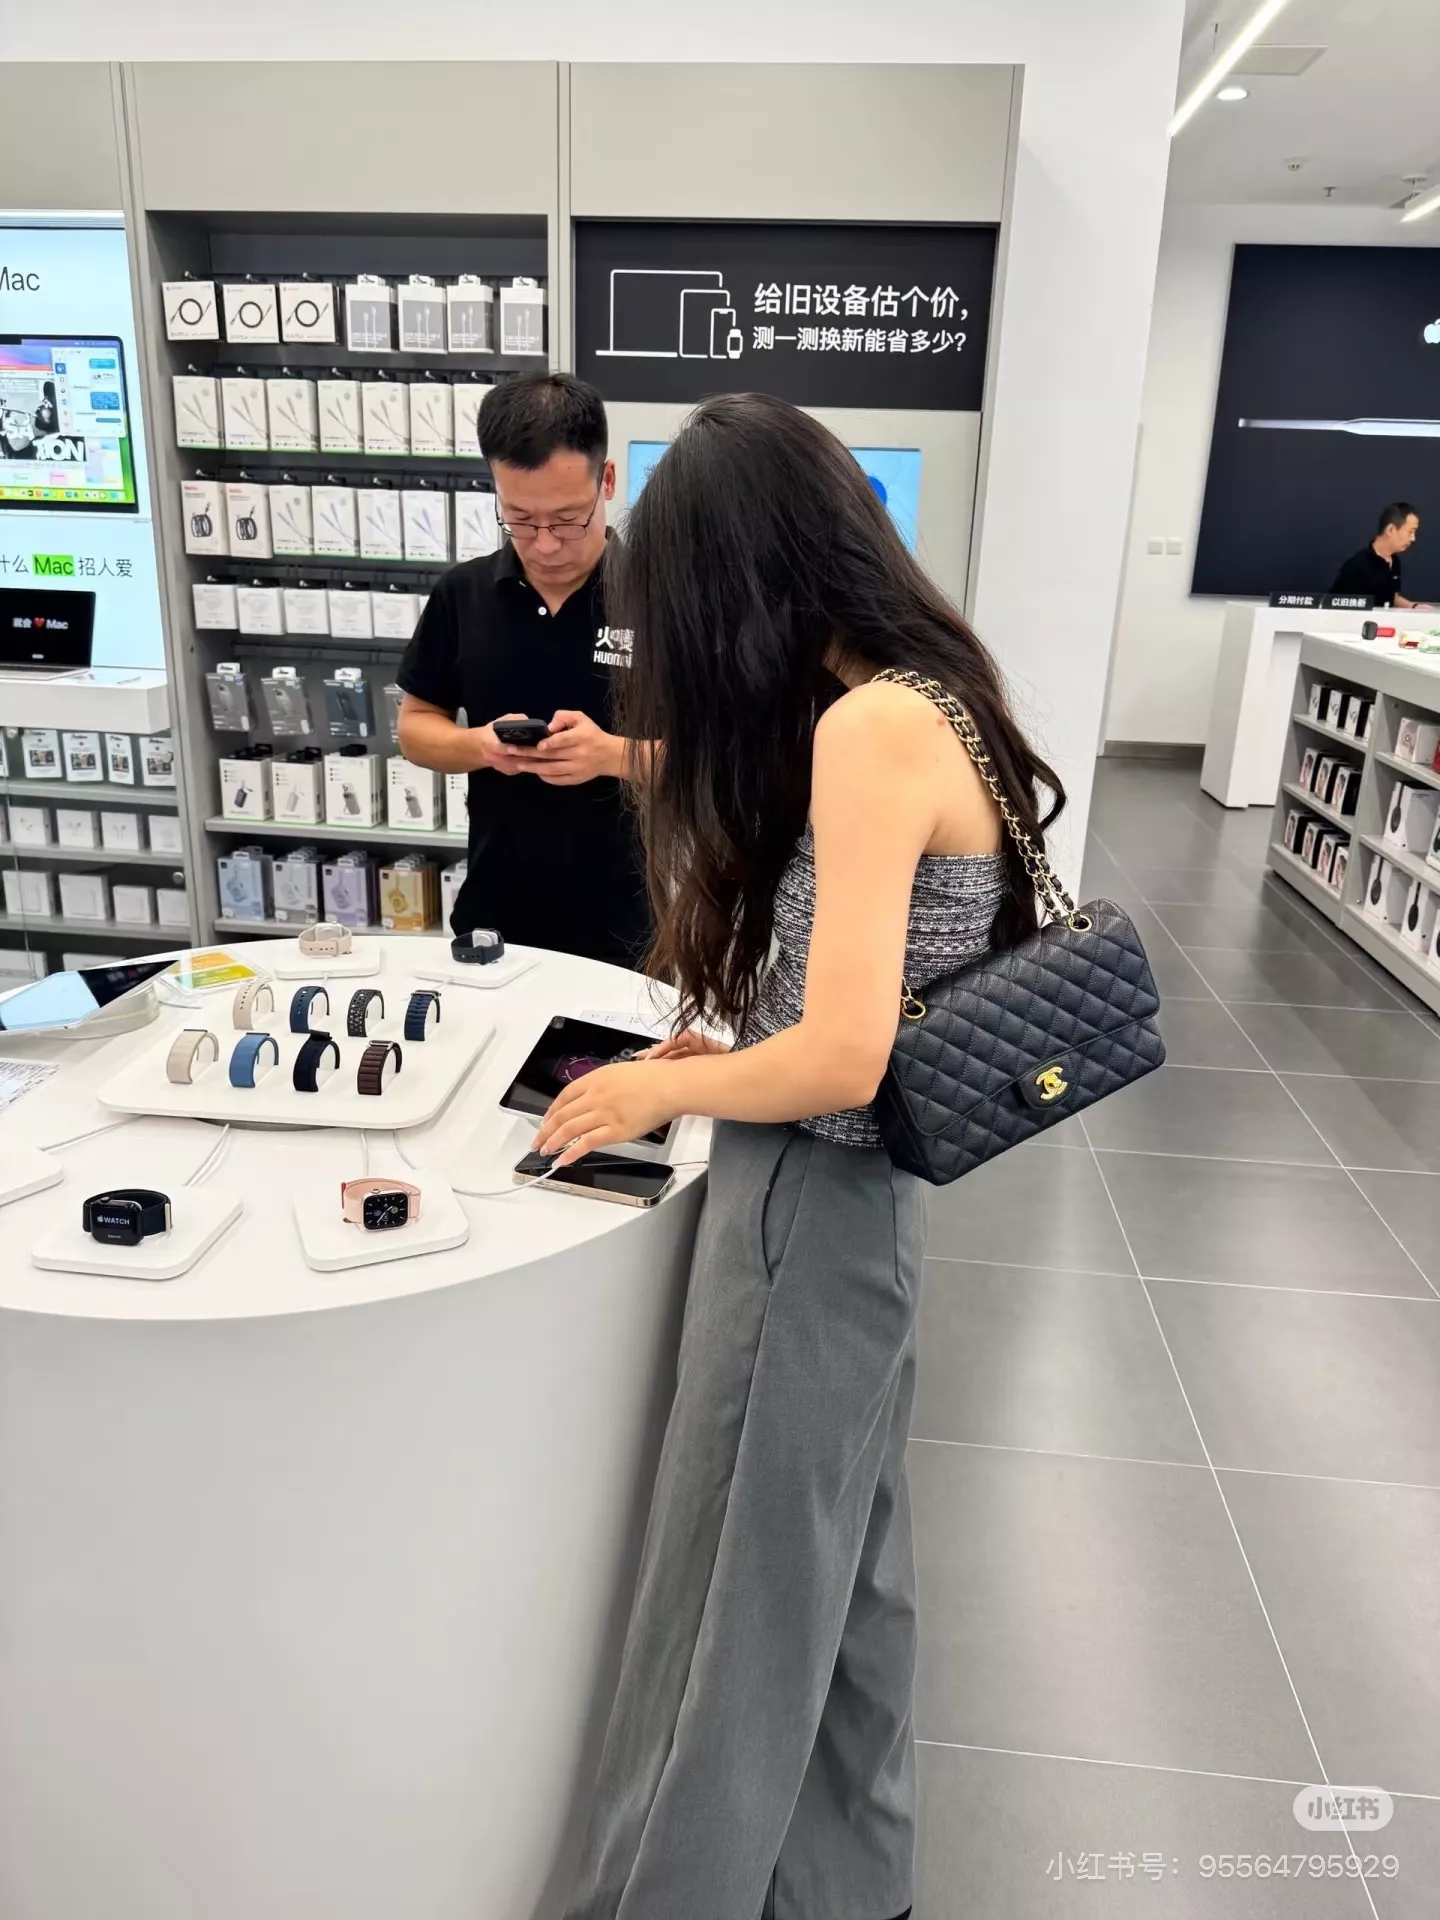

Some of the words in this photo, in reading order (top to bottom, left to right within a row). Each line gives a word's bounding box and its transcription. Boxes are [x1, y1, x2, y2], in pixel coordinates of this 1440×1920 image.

[34, 556, 74, 575] Mac
[78, 557, 133, 577] 招人爱
[1278, 596, 1314, 605] 分期付款
[1331, 598, 1367, 607] 以旧换新
[46, 619, 69, 630] Mac
[104, 1217, 130, 1225] WATCH
